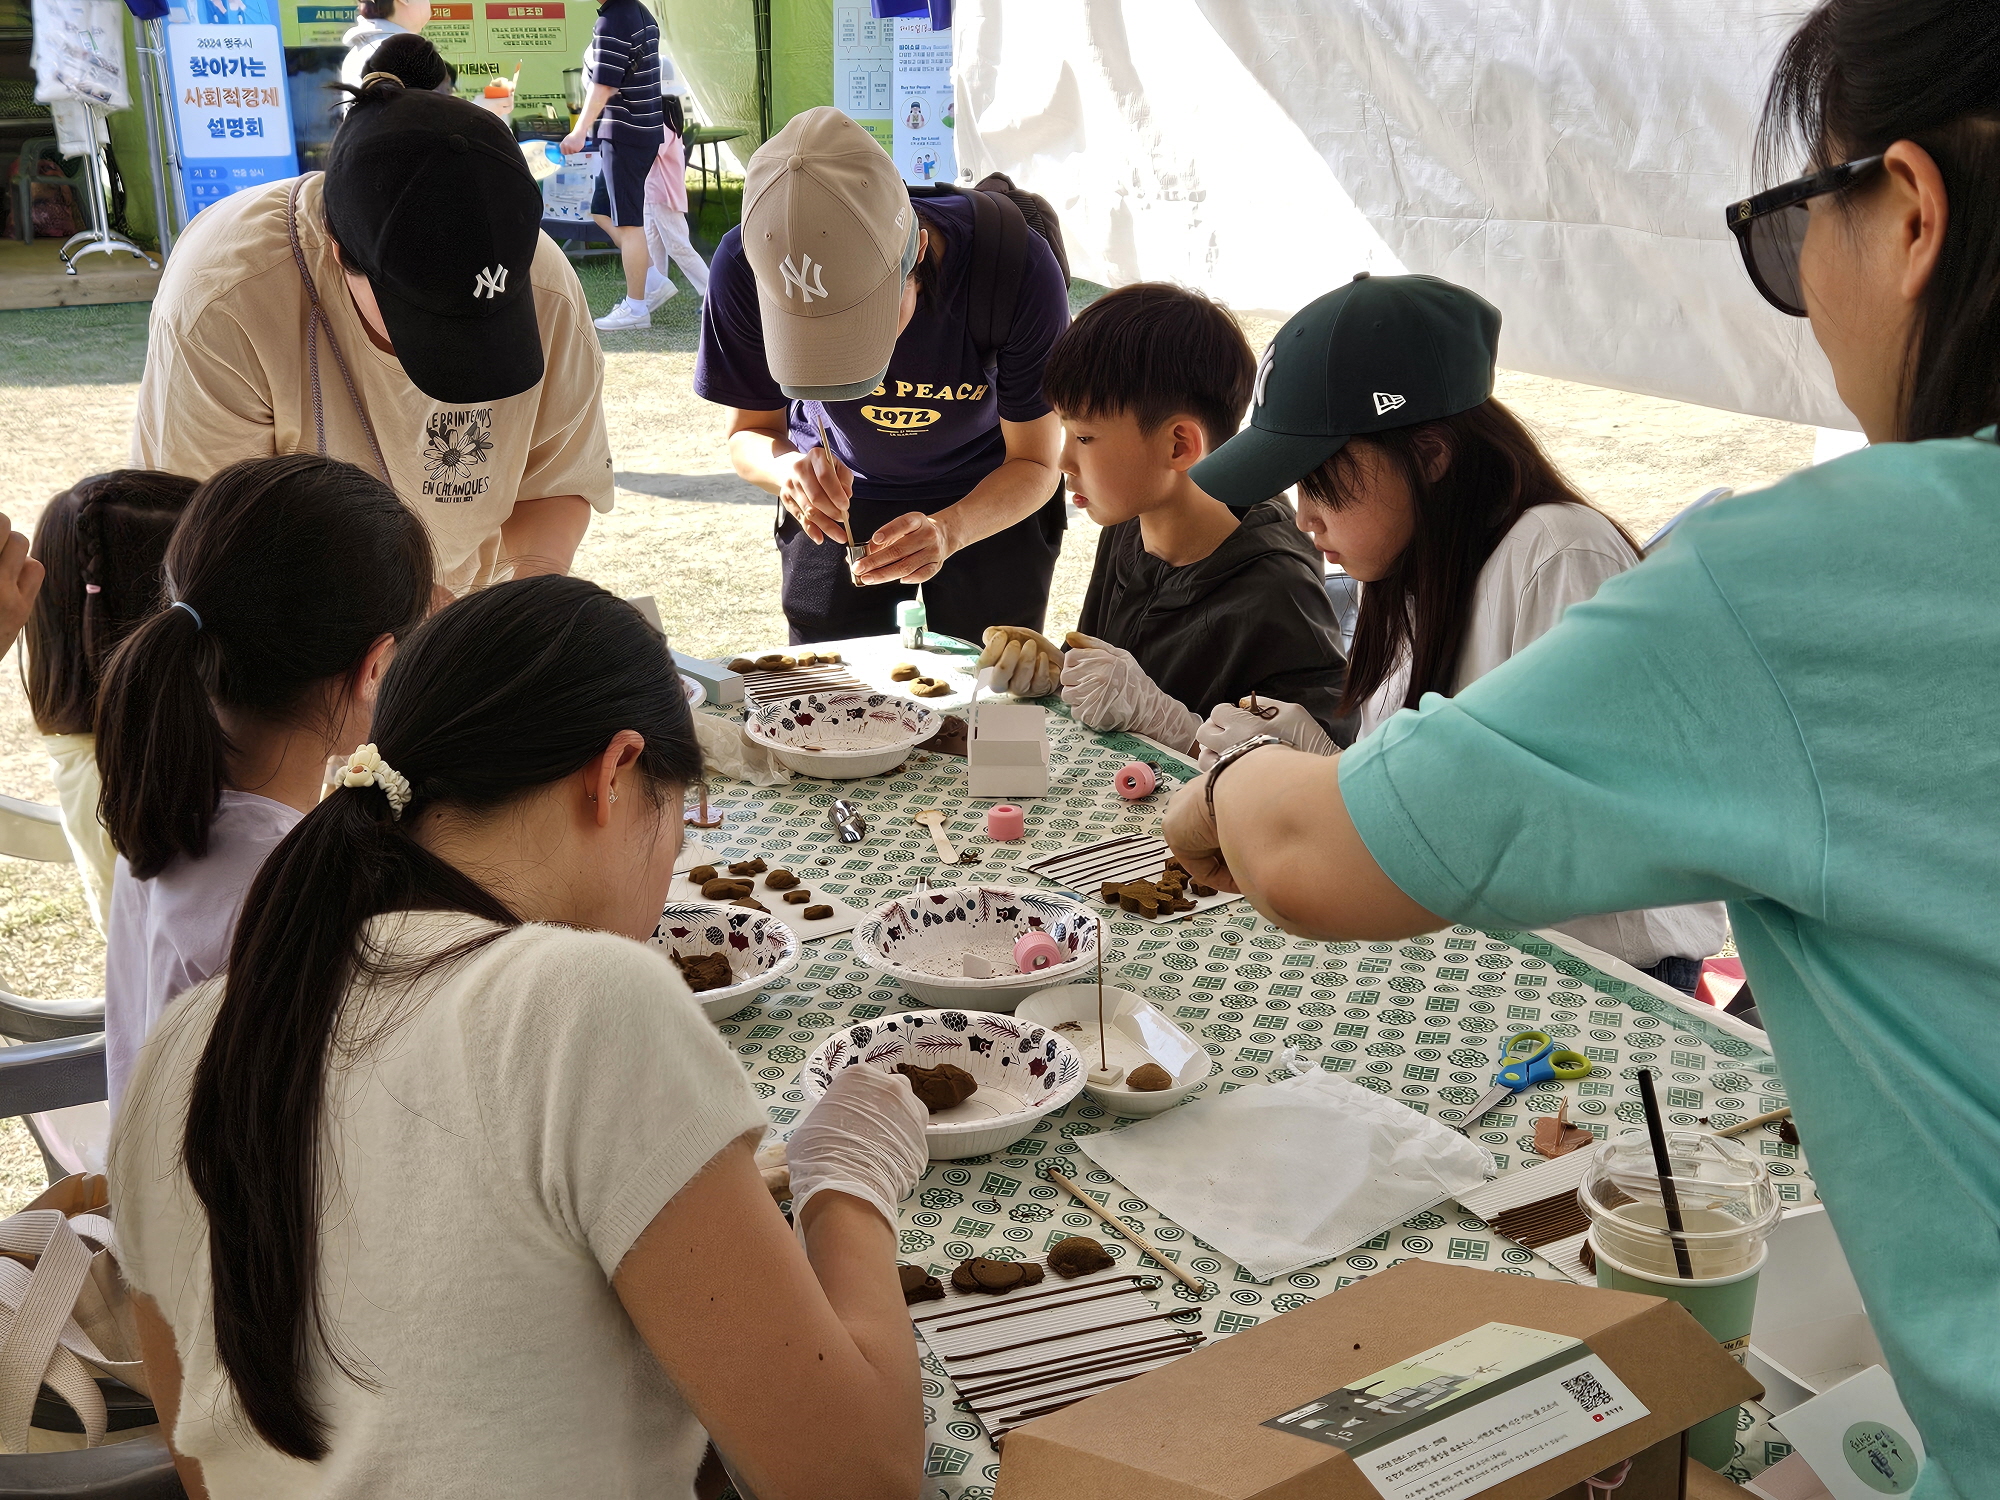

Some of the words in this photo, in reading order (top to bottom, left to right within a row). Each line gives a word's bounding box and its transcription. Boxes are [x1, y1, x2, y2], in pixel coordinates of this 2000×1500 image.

[189, 56, 267, 78] 찾아가는
[183, 86, 280, 109] 사회적경제
[206, 117, 264, 138] 설명회
[895, 380, 989, 401] PEACH
[871, 408, 931, 424] 1972
[422, 480, 434, 495] EN
